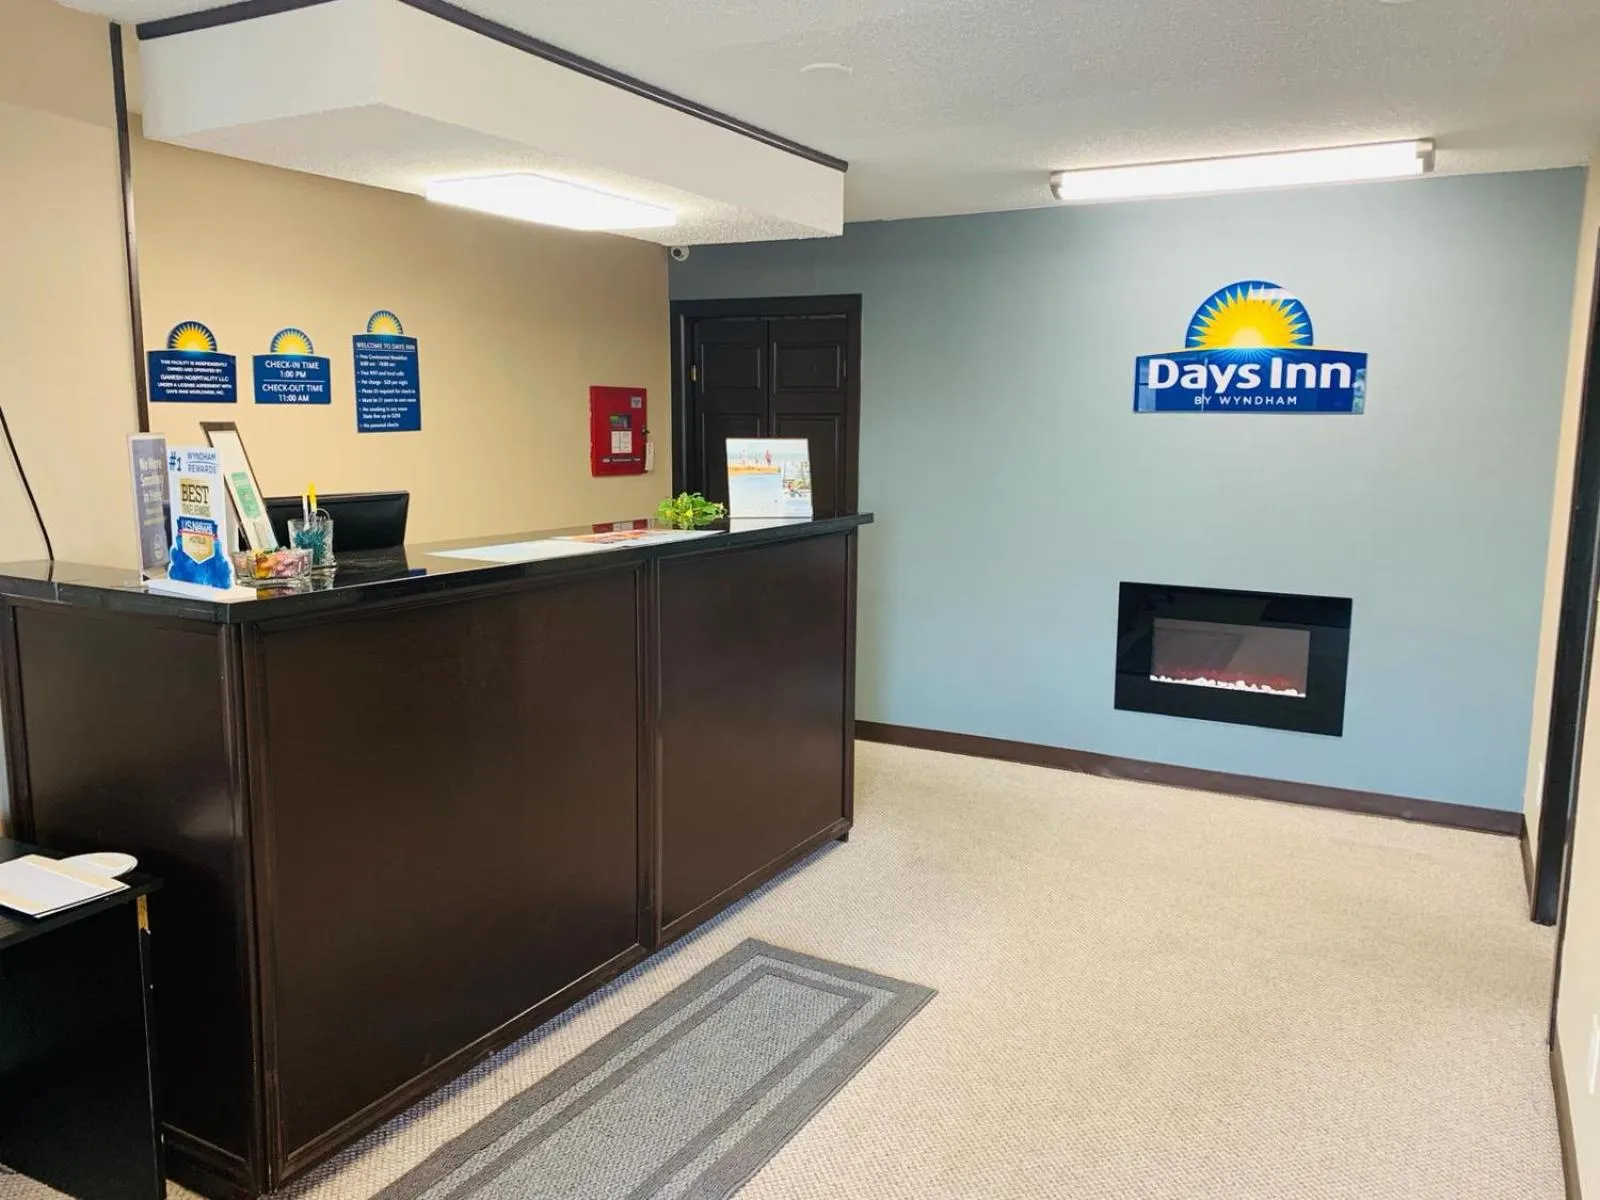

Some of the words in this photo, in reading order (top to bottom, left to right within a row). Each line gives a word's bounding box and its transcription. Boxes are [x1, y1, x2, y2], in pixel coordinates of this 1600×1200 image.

[264, 360, 300, 368] CHECK-IN
[302, 361, 320, 369] TIME
[1148, 358, 1262, 394] Days
[1270, 356, 1352, 390] Inn
[262, 384, 305, 392] CHECK-OUT
[1194, 396, 1212, 405] BY
[1219, 396, 1298, 405] WYNDHAM
[187, 452, 216, 461] WYNDHAM
[181, 484, 210, 504] BEST
